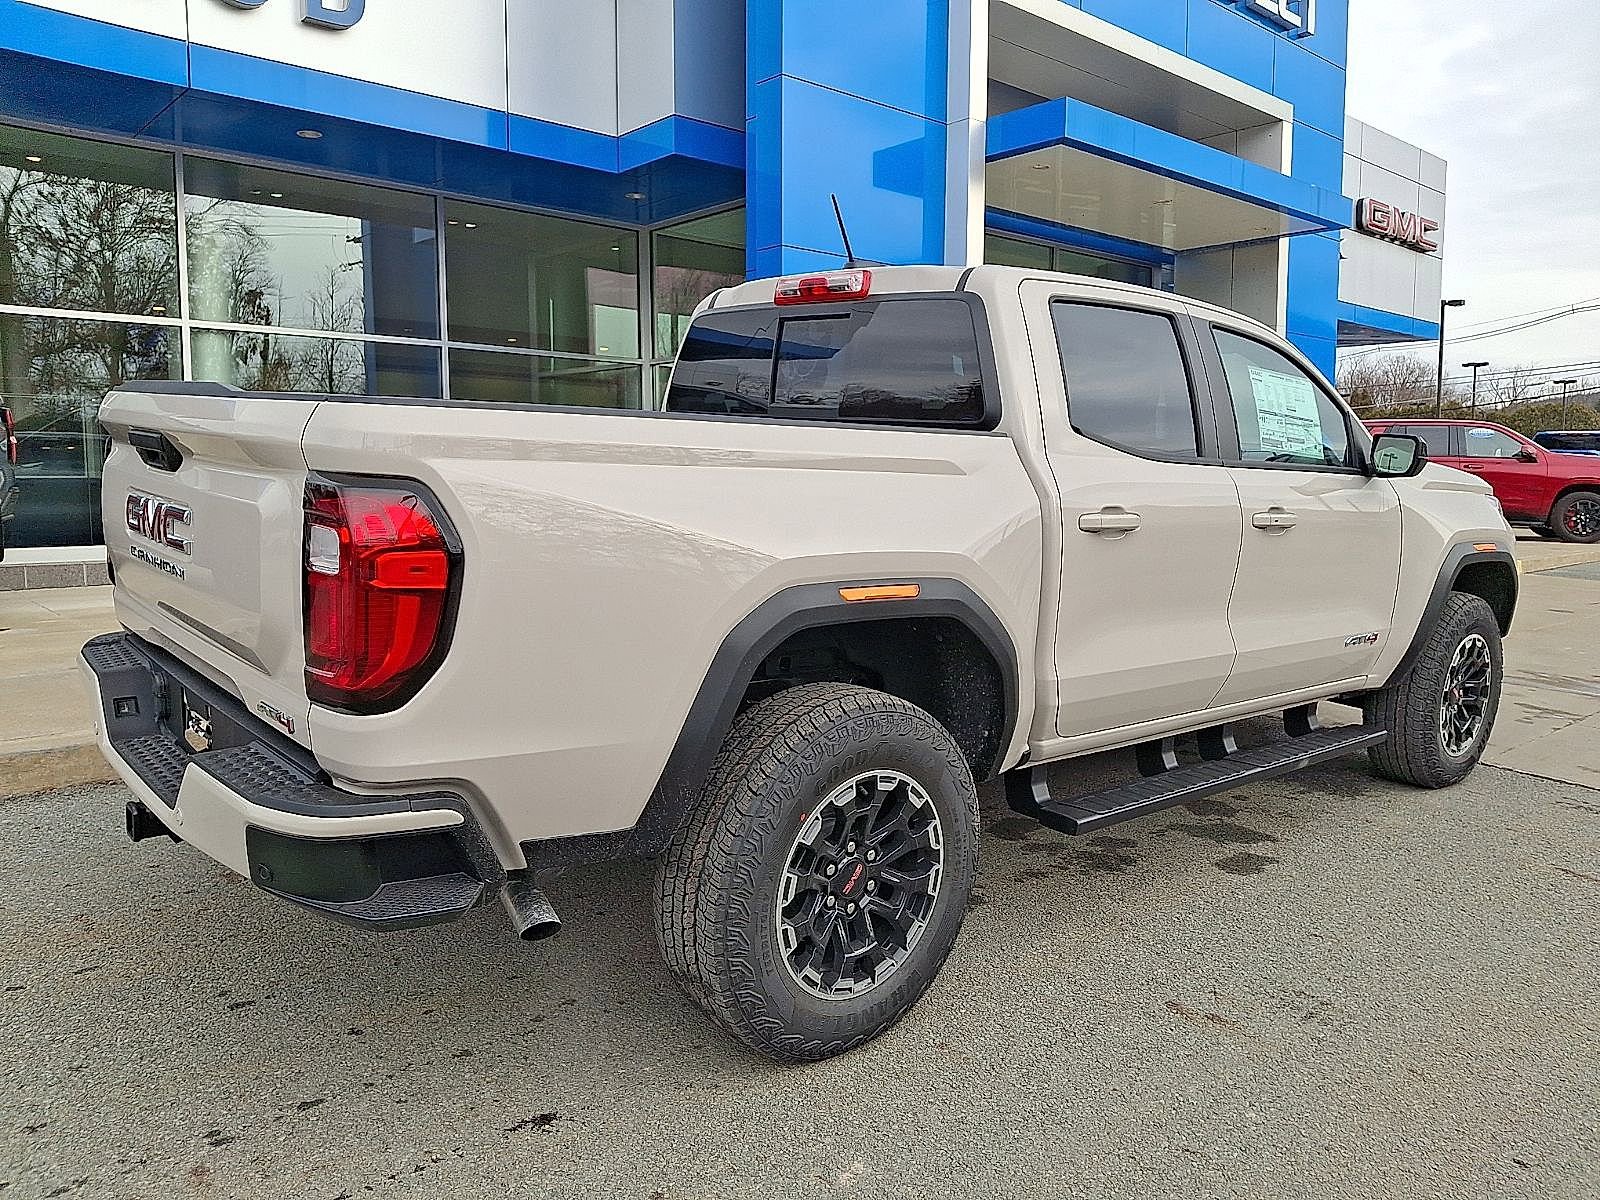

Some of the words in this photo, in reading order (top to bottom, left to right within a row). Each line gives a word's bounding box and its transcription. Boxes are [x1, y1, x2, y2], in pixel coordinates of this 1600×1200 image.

[1362, 198, 1439, 250] GMC
[126, 494, 193, 555] GMC
[130, 546, 185, 580] CANYON
[256, 700, 296, 735] AT4
